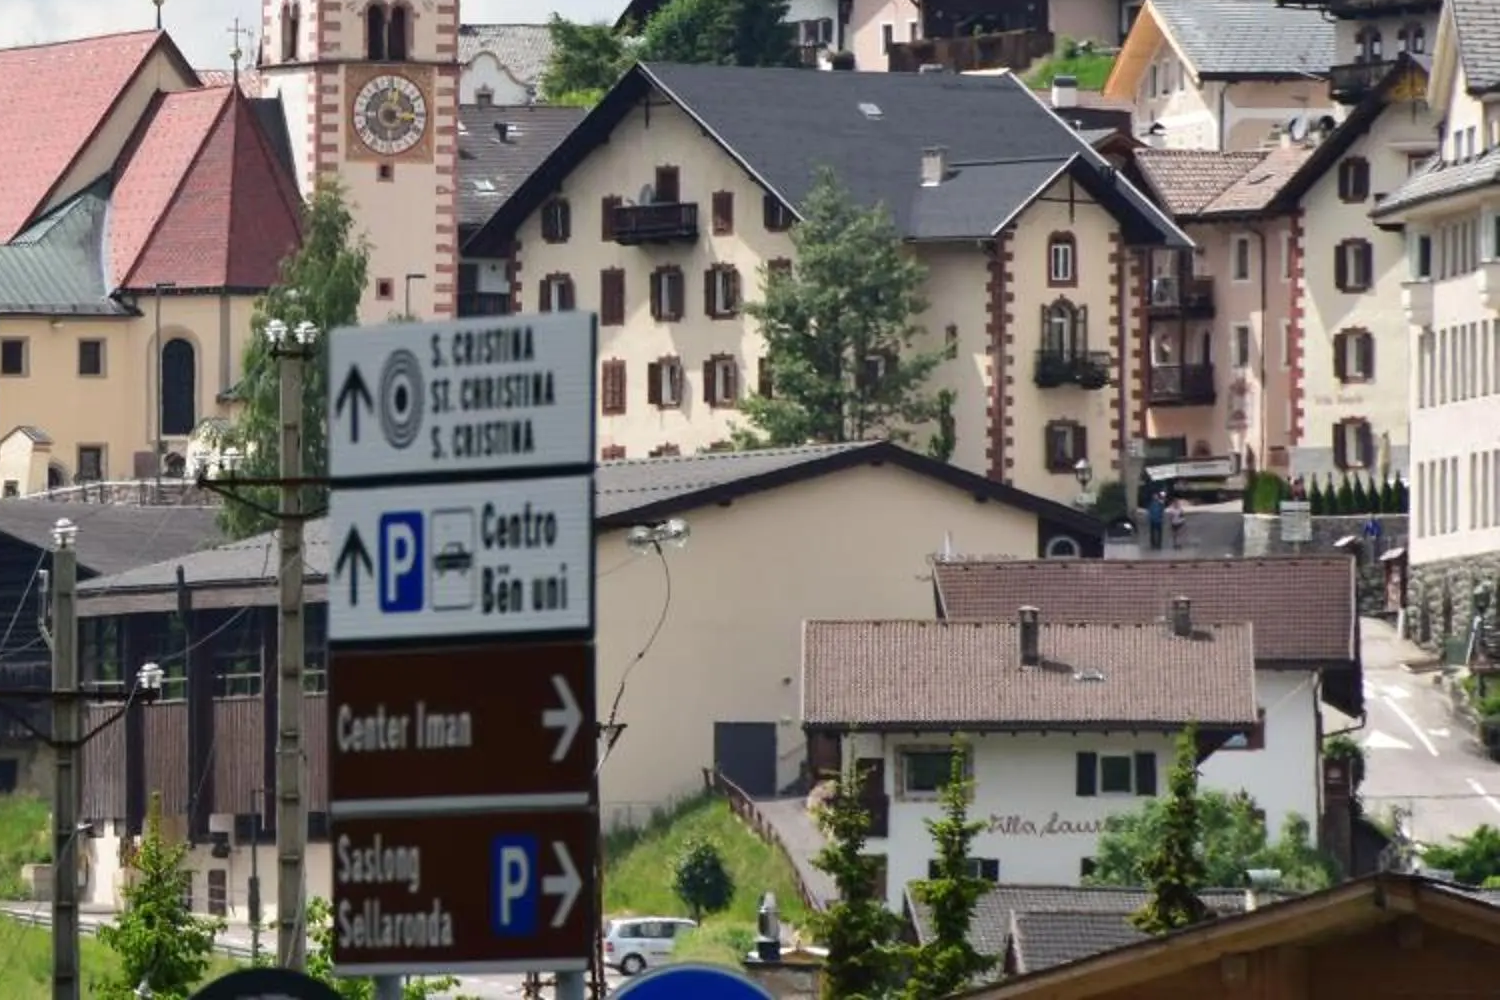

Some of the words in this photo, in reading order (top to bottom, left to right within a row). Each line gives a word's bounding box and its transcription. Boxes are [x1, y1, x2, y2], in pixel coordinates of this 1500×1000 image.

[431, 333, 447, 368] S.
[452, 326, 534, 366] CRISTINA
[431, 379, 455, 414] ST.
[460, 371, 555, 411] CHRISTINA
[431, 425, 447, 460] S.
[452, 419, 535, 458] CRISTINA
[482, 502, 557, 550] Centro
[386, 522, 415, 603] P
[482, 563, 523, 615] Bën
[532, 563, 568, 611] uni
[337, 702, 409, 751] Center
[416, 701, 472, 748] Iman
[338, 833, 420, 893] Saslong
[501, 845, 530, 926] P
[338, 898, 453, 948] Sellaronda
